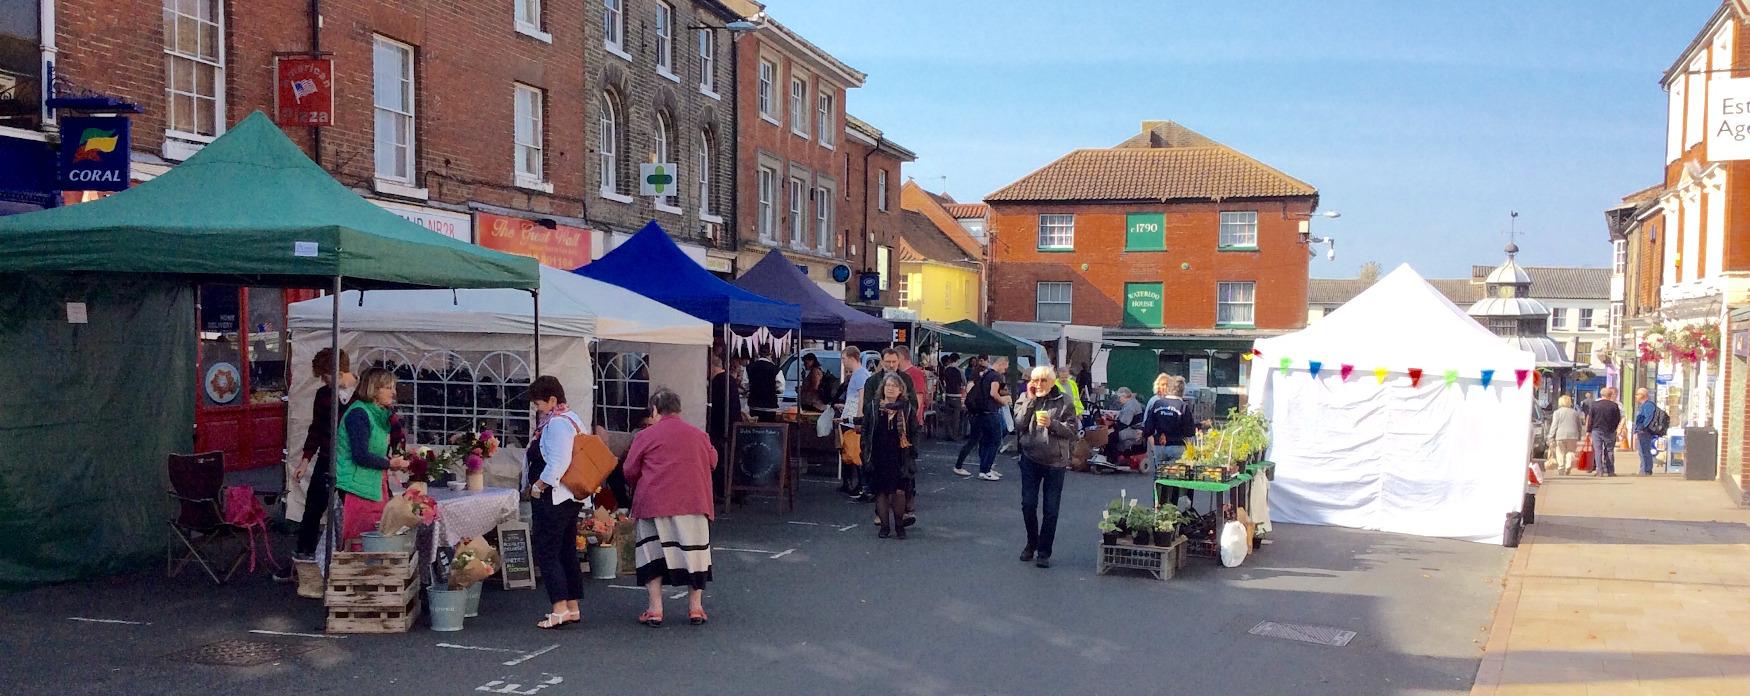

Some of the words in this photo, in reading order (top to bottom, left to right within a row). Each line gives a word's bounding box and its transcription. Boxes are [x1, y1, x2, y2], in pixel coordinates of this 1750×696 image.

[69, 169, 121, 181] CORAL
[491, 219, 514, 238] The
[1128, 290, 1160, 300] WATERLOO
